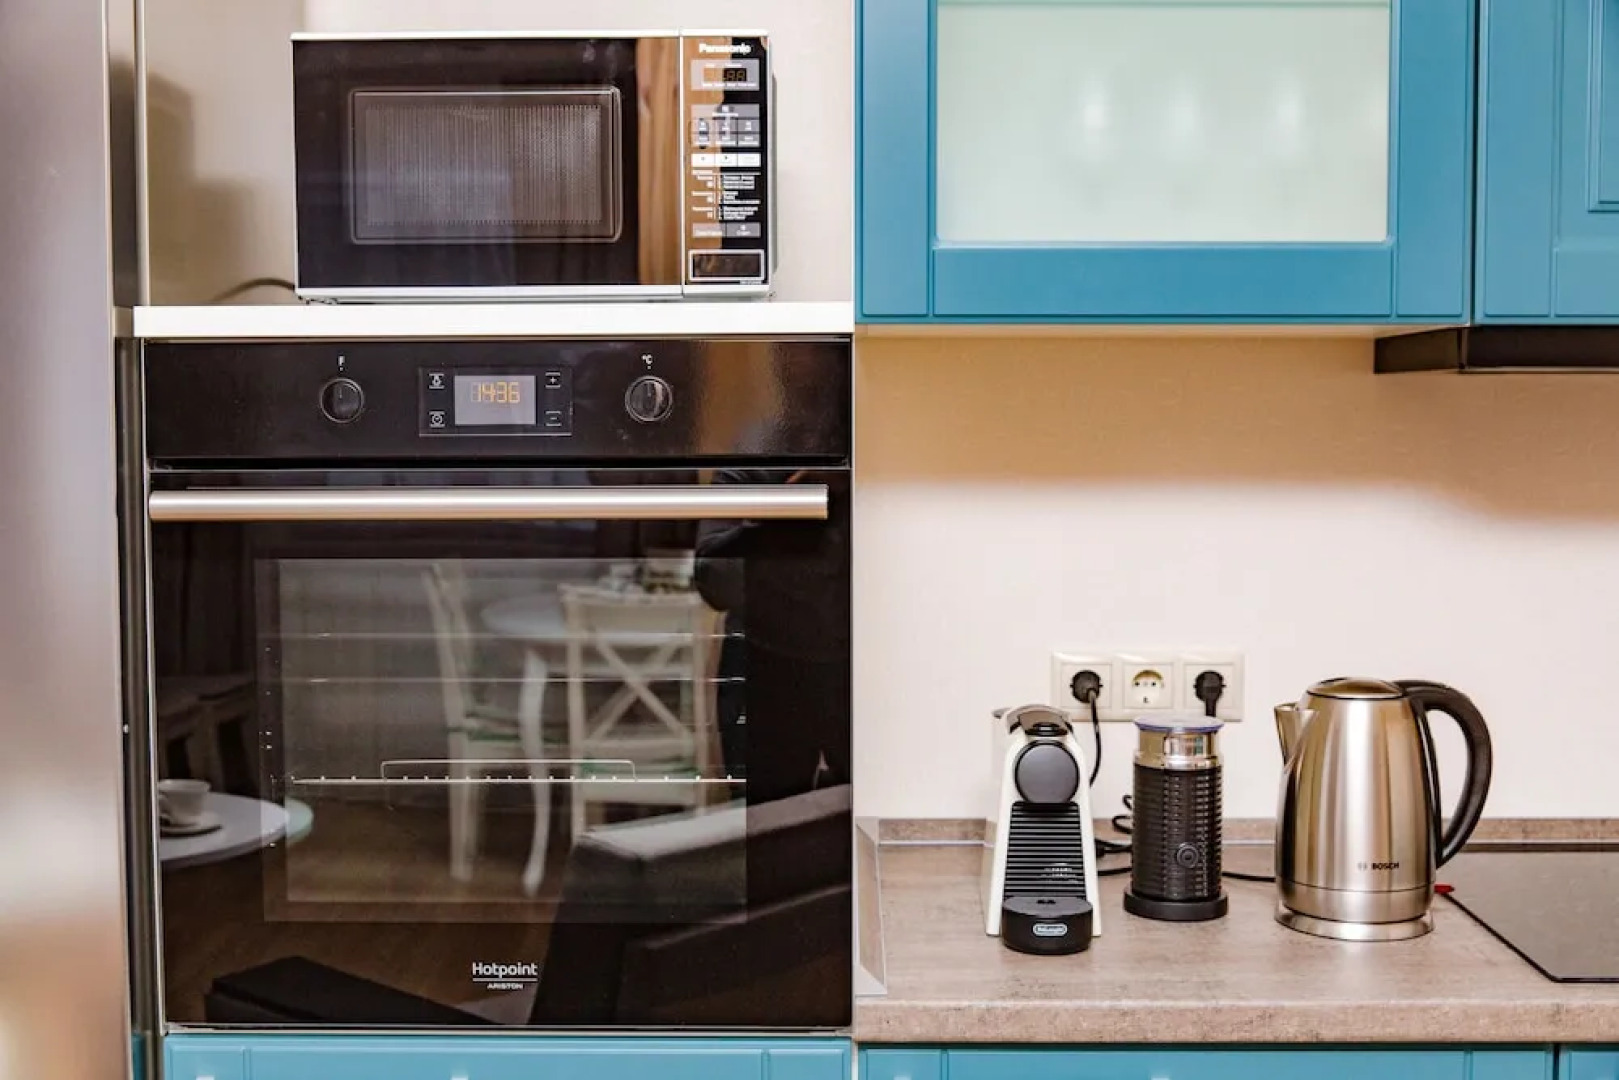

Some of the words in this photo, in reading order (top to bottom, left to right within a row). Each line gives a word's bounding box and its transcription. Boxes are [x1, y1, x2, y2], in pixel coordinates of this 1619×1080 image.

[698, 43, 752, 55] Panasonic
[1371, 862, 1400, 870] BOSCH
[472, 962, 538, 979] Hotpoint
